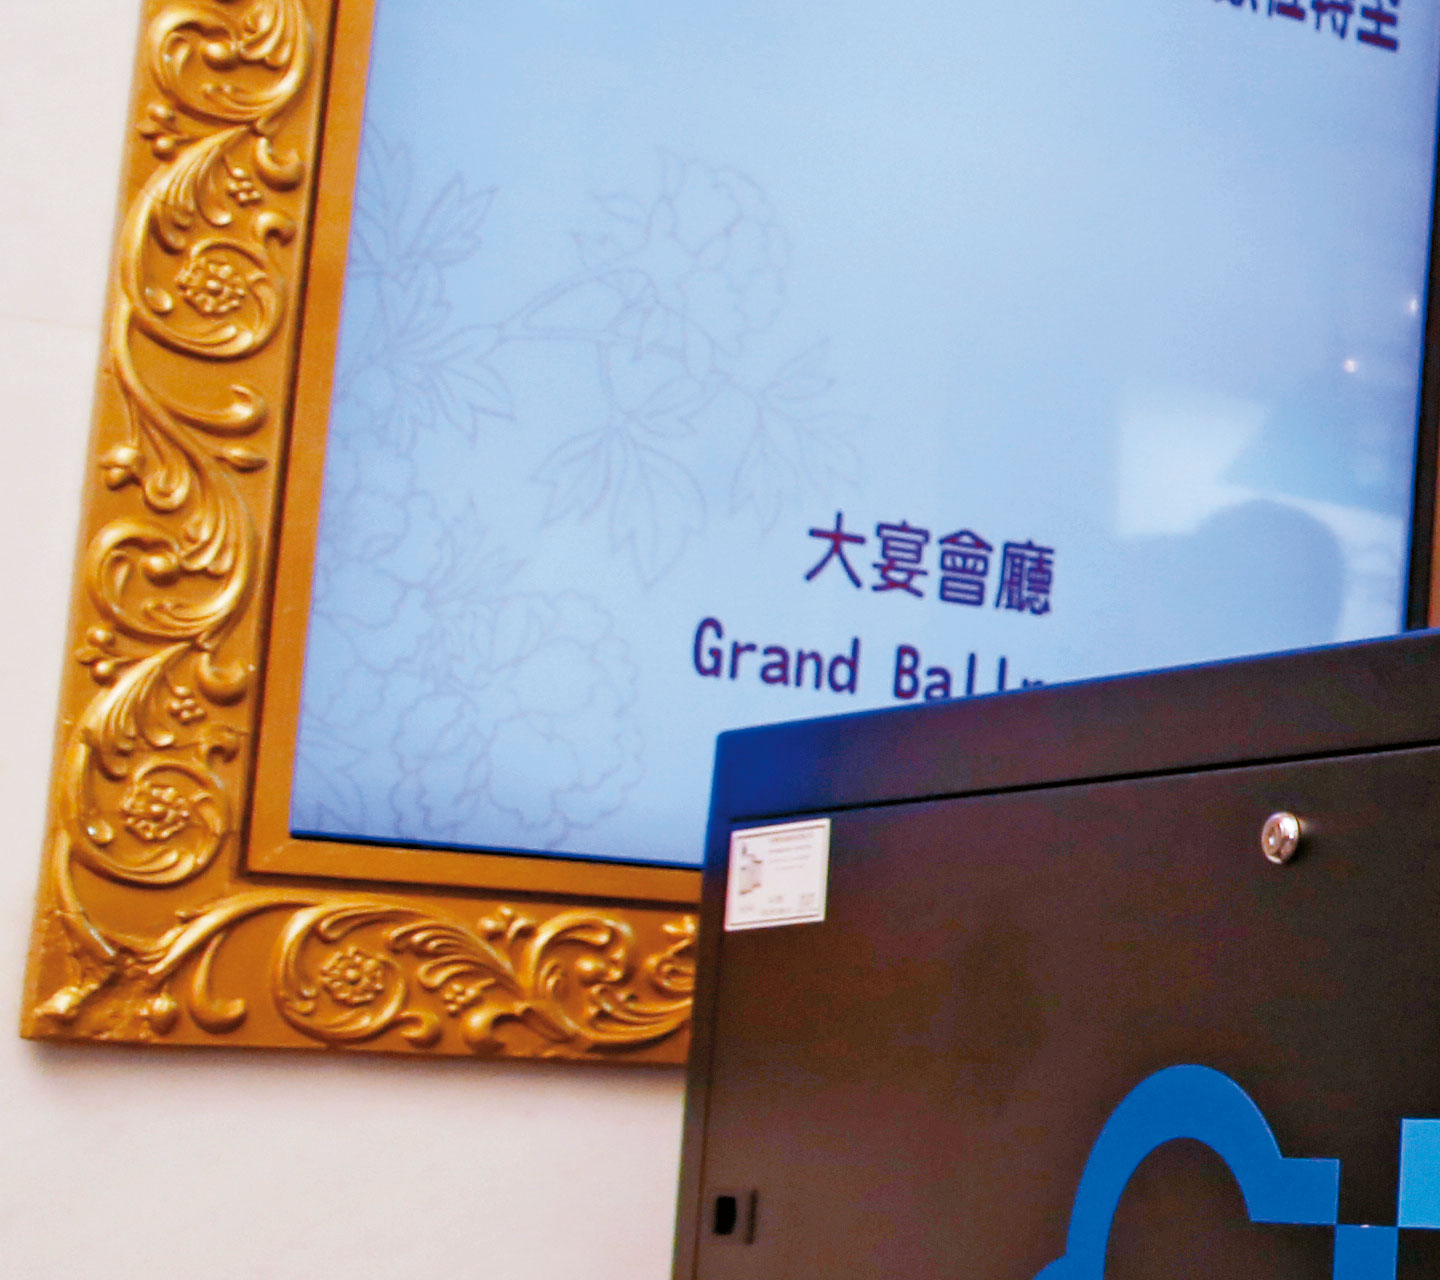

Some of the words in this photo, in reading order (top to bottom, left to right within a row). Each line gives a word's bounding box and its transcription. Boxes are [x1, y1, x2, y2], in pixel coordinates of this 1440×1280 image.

[805, 511, 1055, 615] 大宴會廳
[693, 617, 860, 695] Grand
